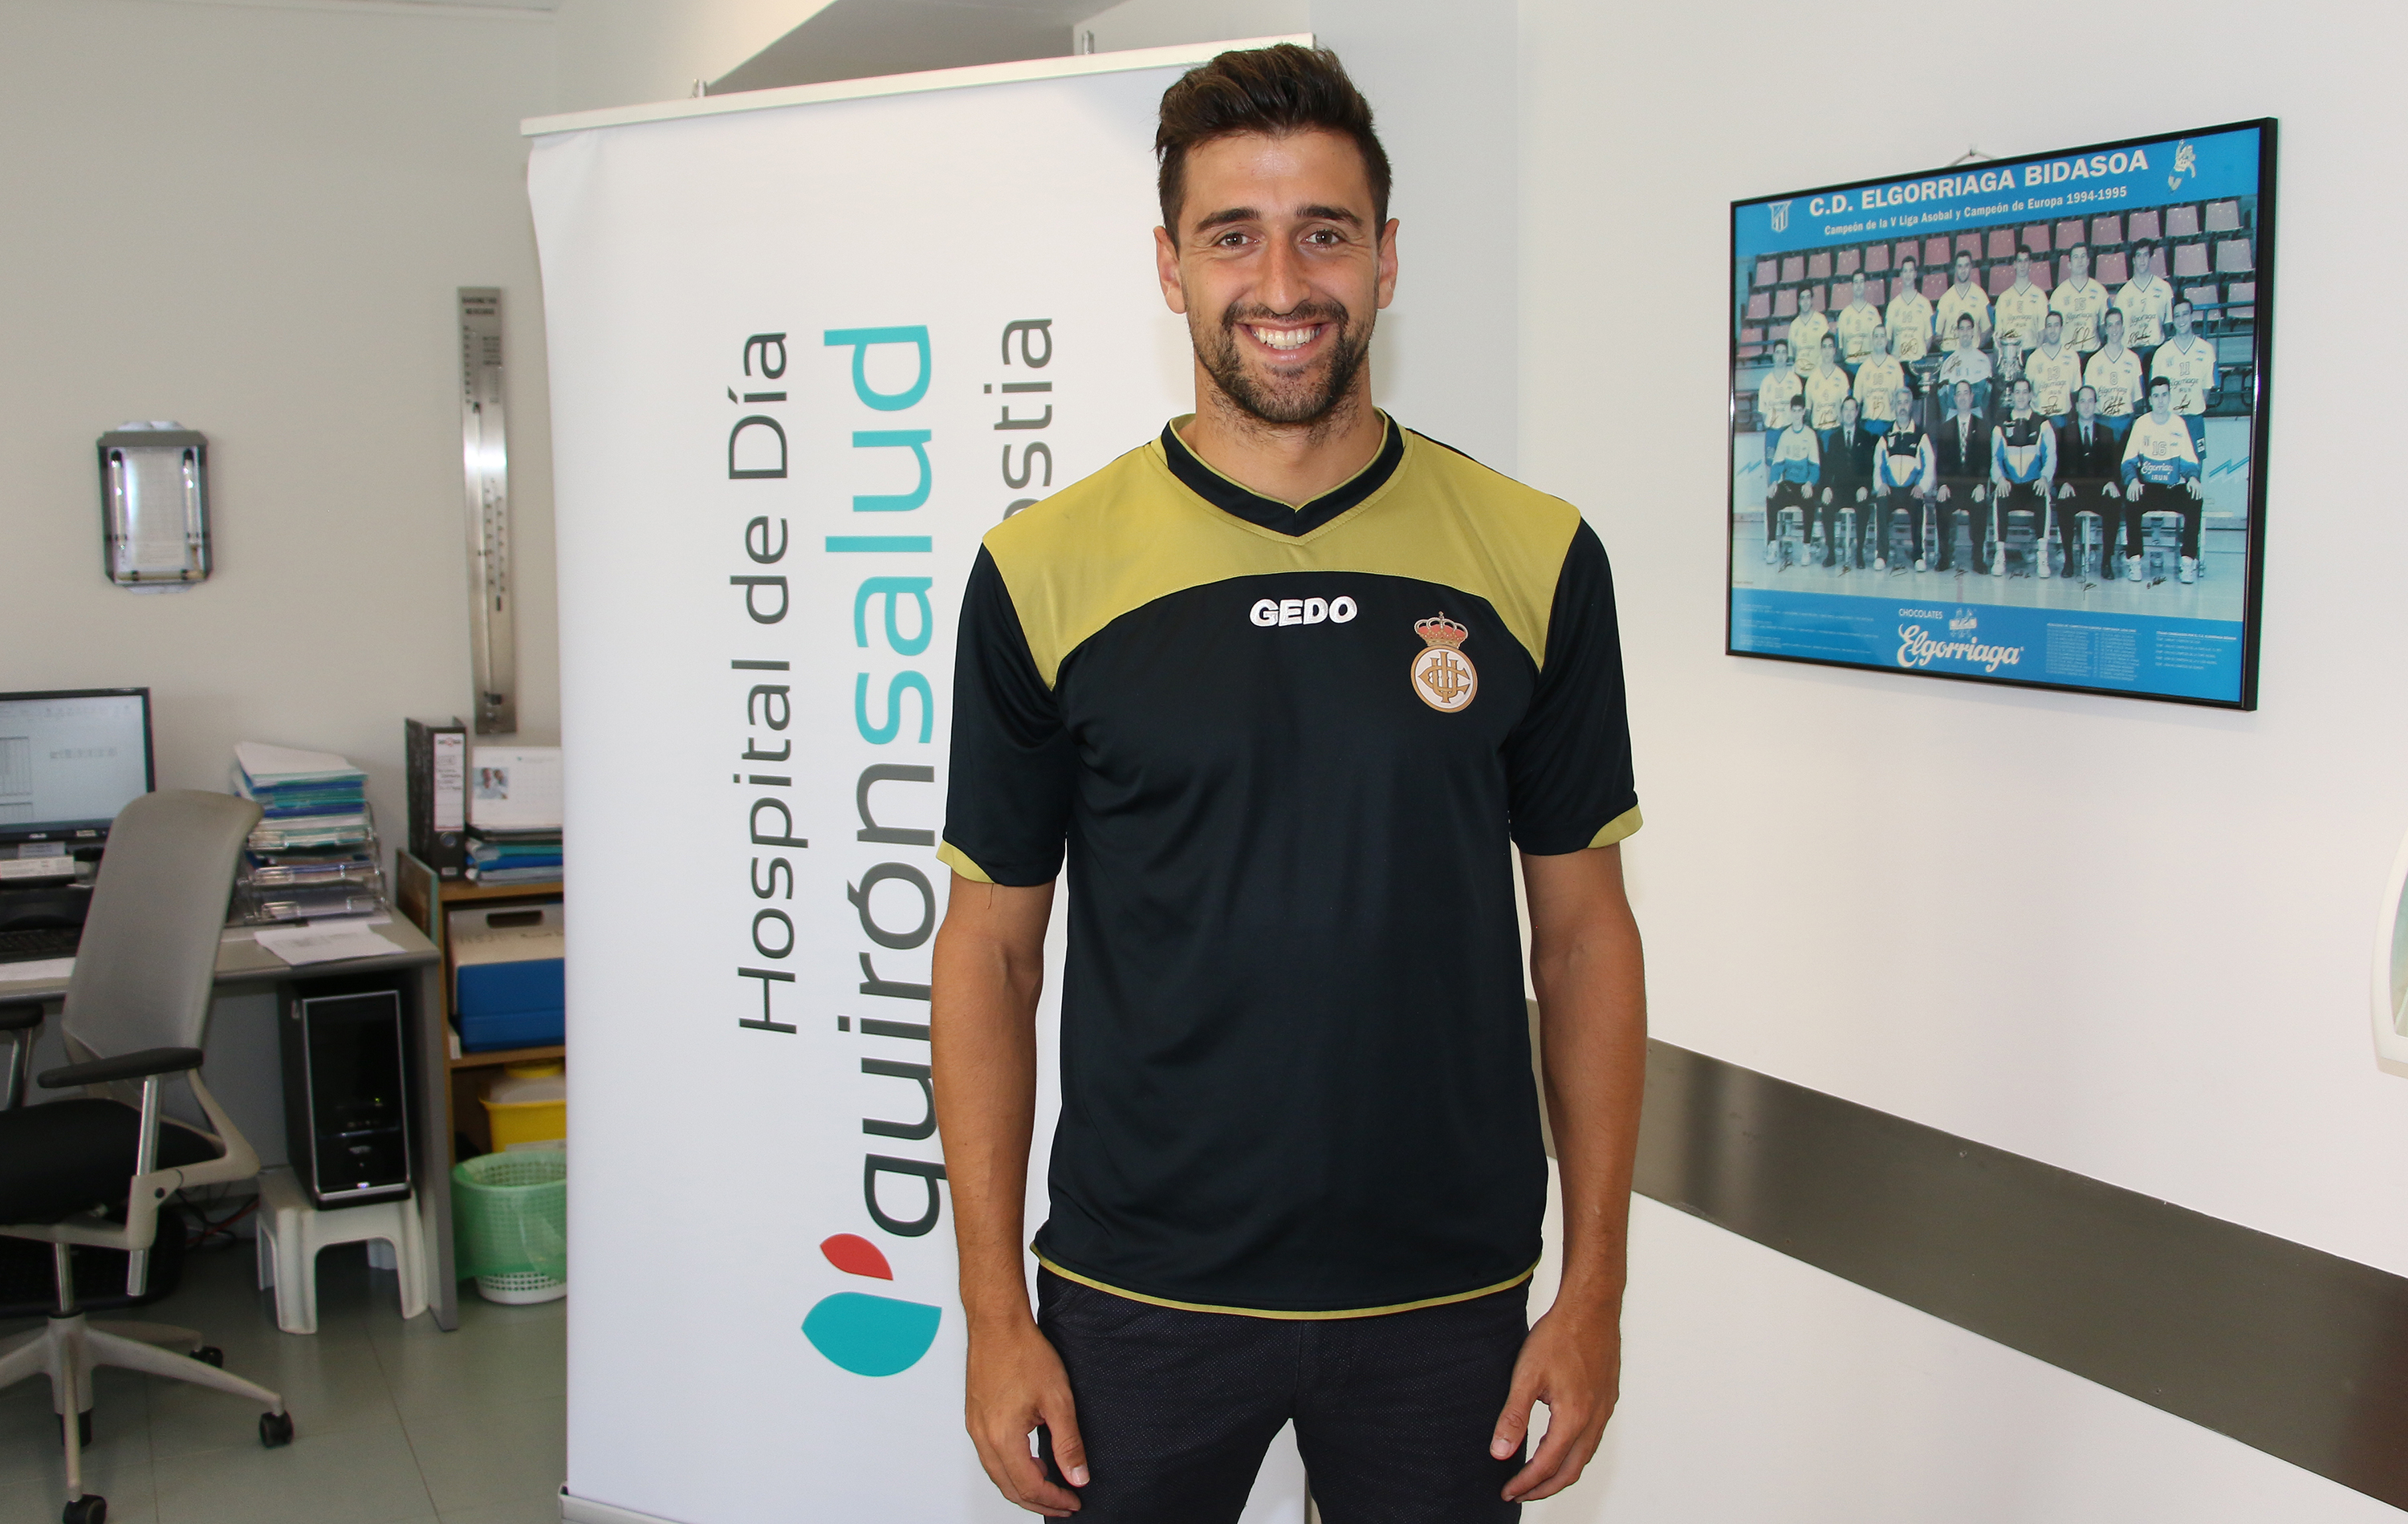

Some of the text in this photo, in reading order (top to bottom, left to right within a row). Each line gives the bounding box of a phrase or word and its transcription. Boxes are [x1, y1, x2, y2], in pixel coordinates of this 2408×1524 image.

[1809, 149, 2149, 217] C.D. ELGORRIAGA BIDASOA
[1824, 185, 2128, 235] Campeón de la V Liga Asobal y Campeón de Europa 1994-1995
[1249, 595, 1358, 627] GEDO
[1898, 608, 1943, 620] CHOCOLATES
[1897, 623, 2021, 673] Elgorriaga
[727, 331, 807, 1034] Hospital de Día
[824, 325, 948, 1237] quirónsalud
